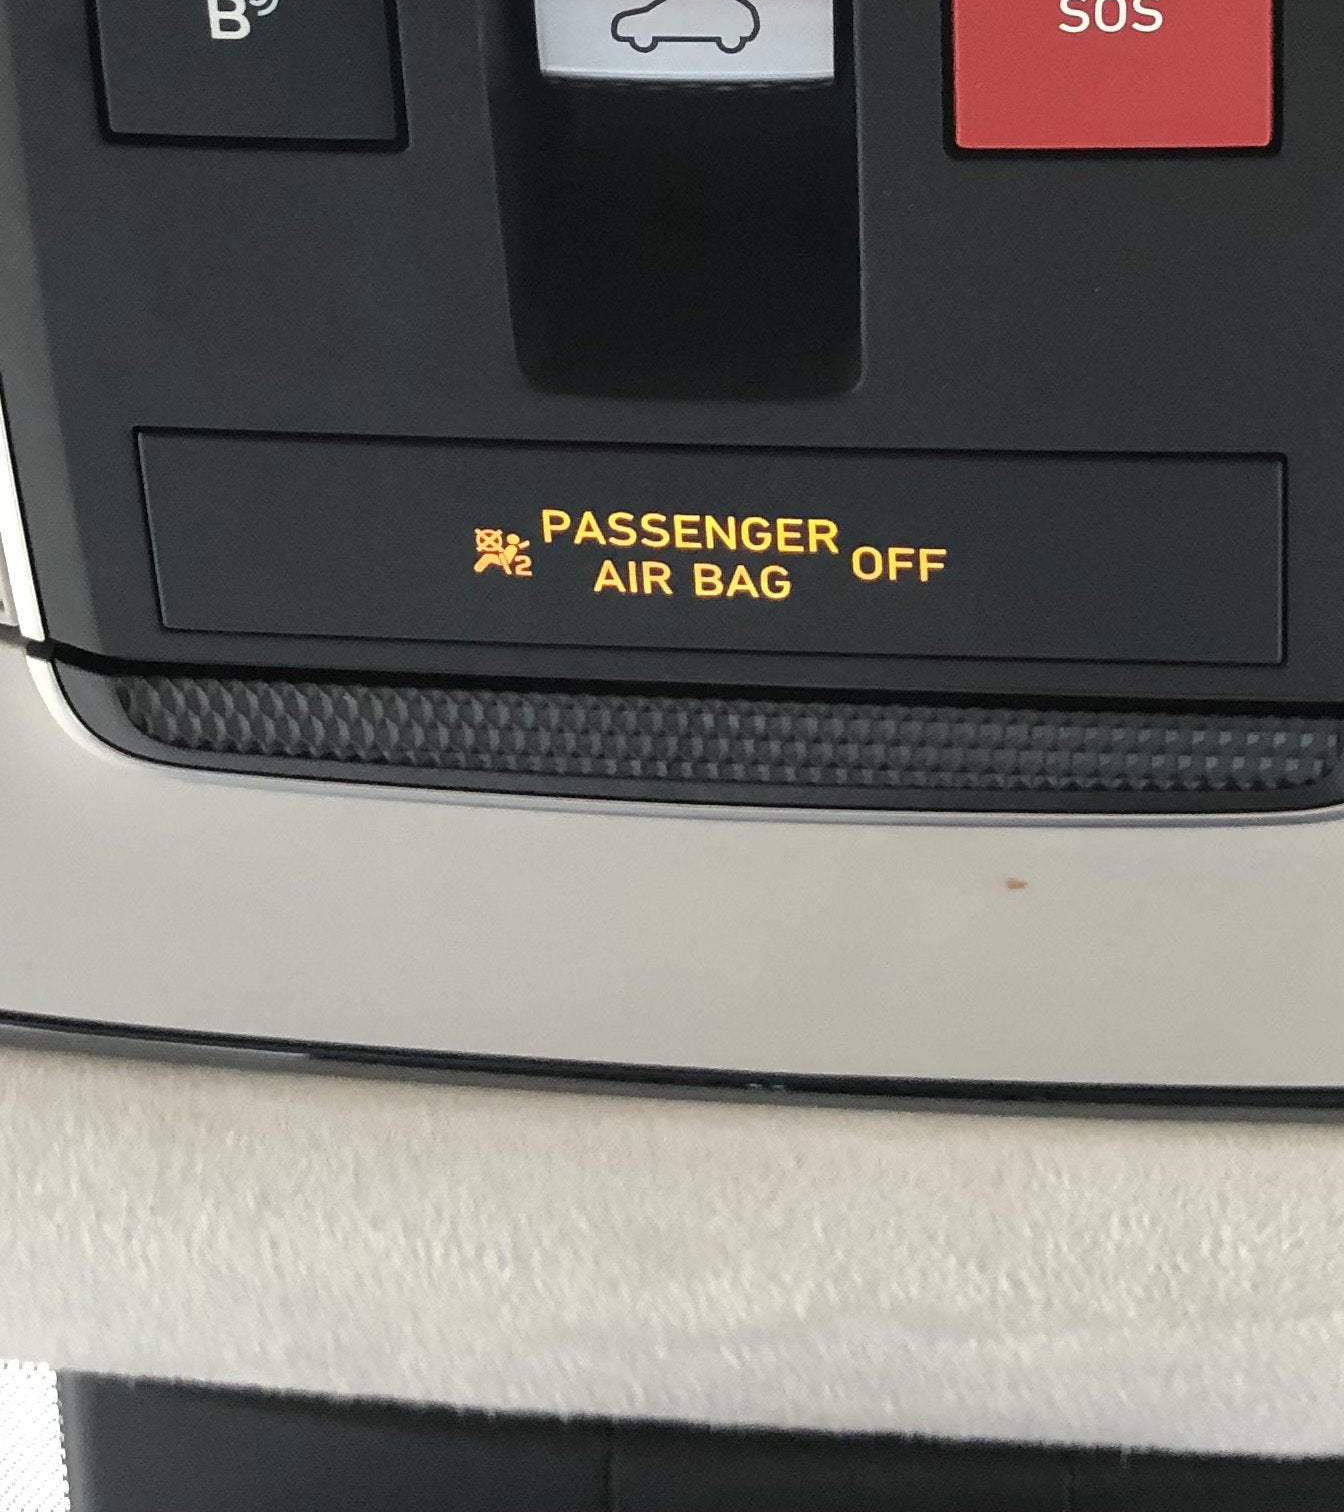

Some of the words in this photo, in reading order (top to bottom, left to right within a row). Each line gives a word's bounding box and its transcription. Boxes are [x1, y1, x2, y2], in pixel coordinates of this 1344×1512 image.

[541, 509, 839, 554] PASSENGER
[593, 560, 673, 596] AIR
[693, 565, 792, 600] BAG
[852, 546, 948, 582] OFF
